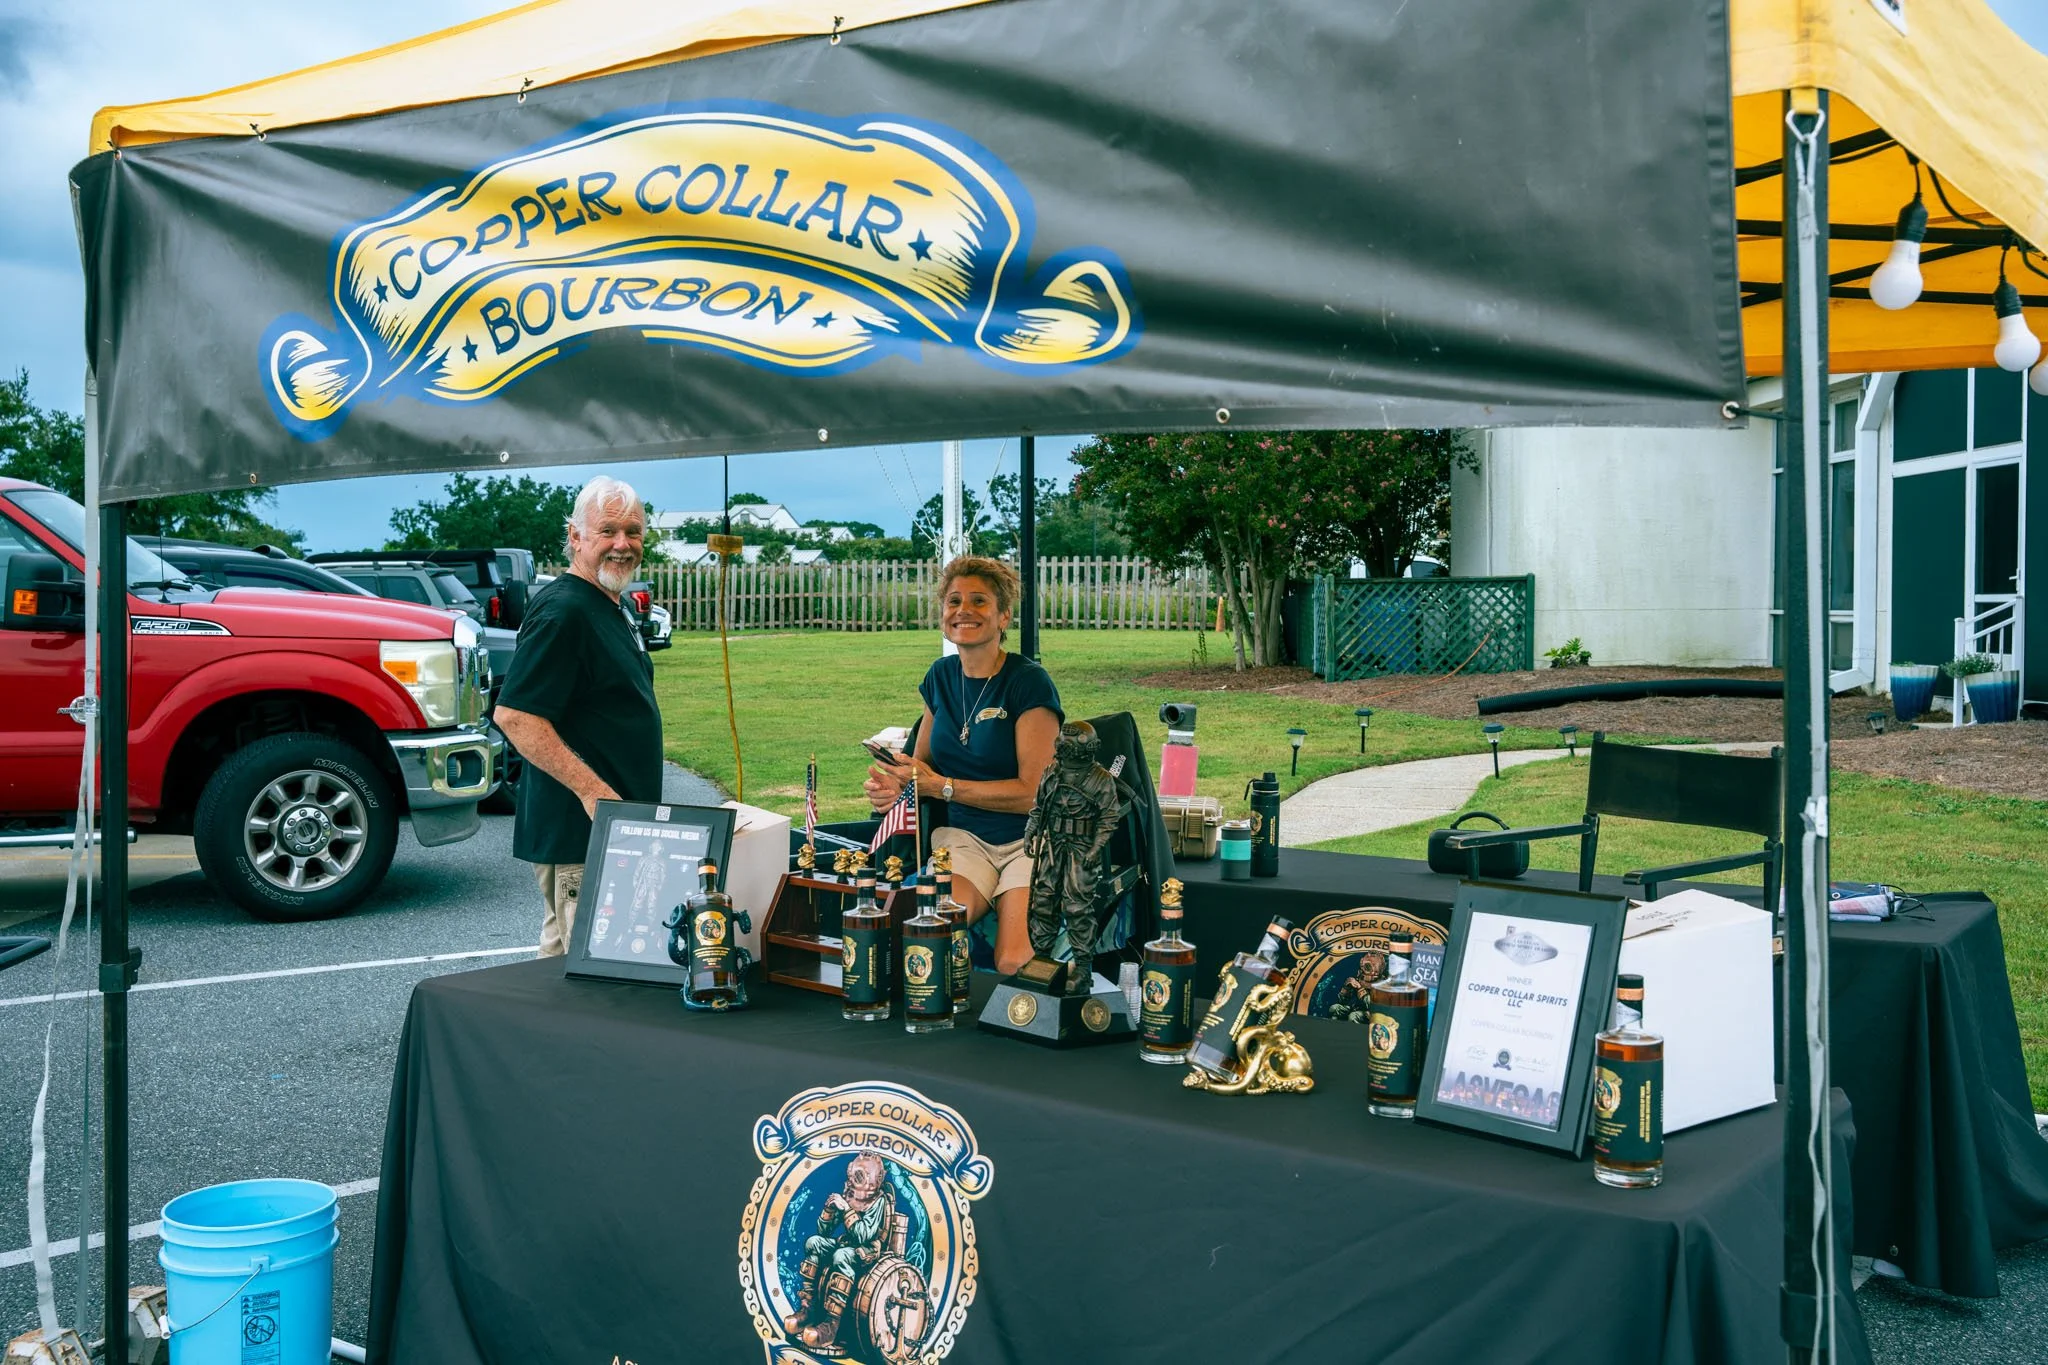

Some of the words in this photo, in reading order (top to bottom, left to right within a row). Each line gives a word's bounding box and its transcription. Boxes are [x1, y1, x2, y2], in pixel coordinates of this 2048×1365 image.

[389, 171, 623, 300] COPPER
[635, 163, 903, 262] COLLAR
[479, 277, 815, 355] BOURBON
[313, 757, 379, 808] MICHELIN
[620, 825, 643, 836] FOLLOW
[661, 829, 681, 840] SOCIAL
[236, 856, 304, 906] MICHELIN
[1325, 919, 1378, 937] COPPER
[1345, 939, 1390, 950] BOURB
[1415, 953, 1441, 966] MAN
[1412, 966, 1438, 983] SEA
[1467, 983, 1500, 996] COPPER
[1501, 988, 1535, 1001] COLLAR
[1536, 994, 1569, 1007] SPIRITS
[1507, 998, 1523, 1008] LLC
[803, 1102, 875, 1127] COPPER
[879, 1103, 947, 1148] COLLAR
[828, 1132, 918, 1161] BOURBON
